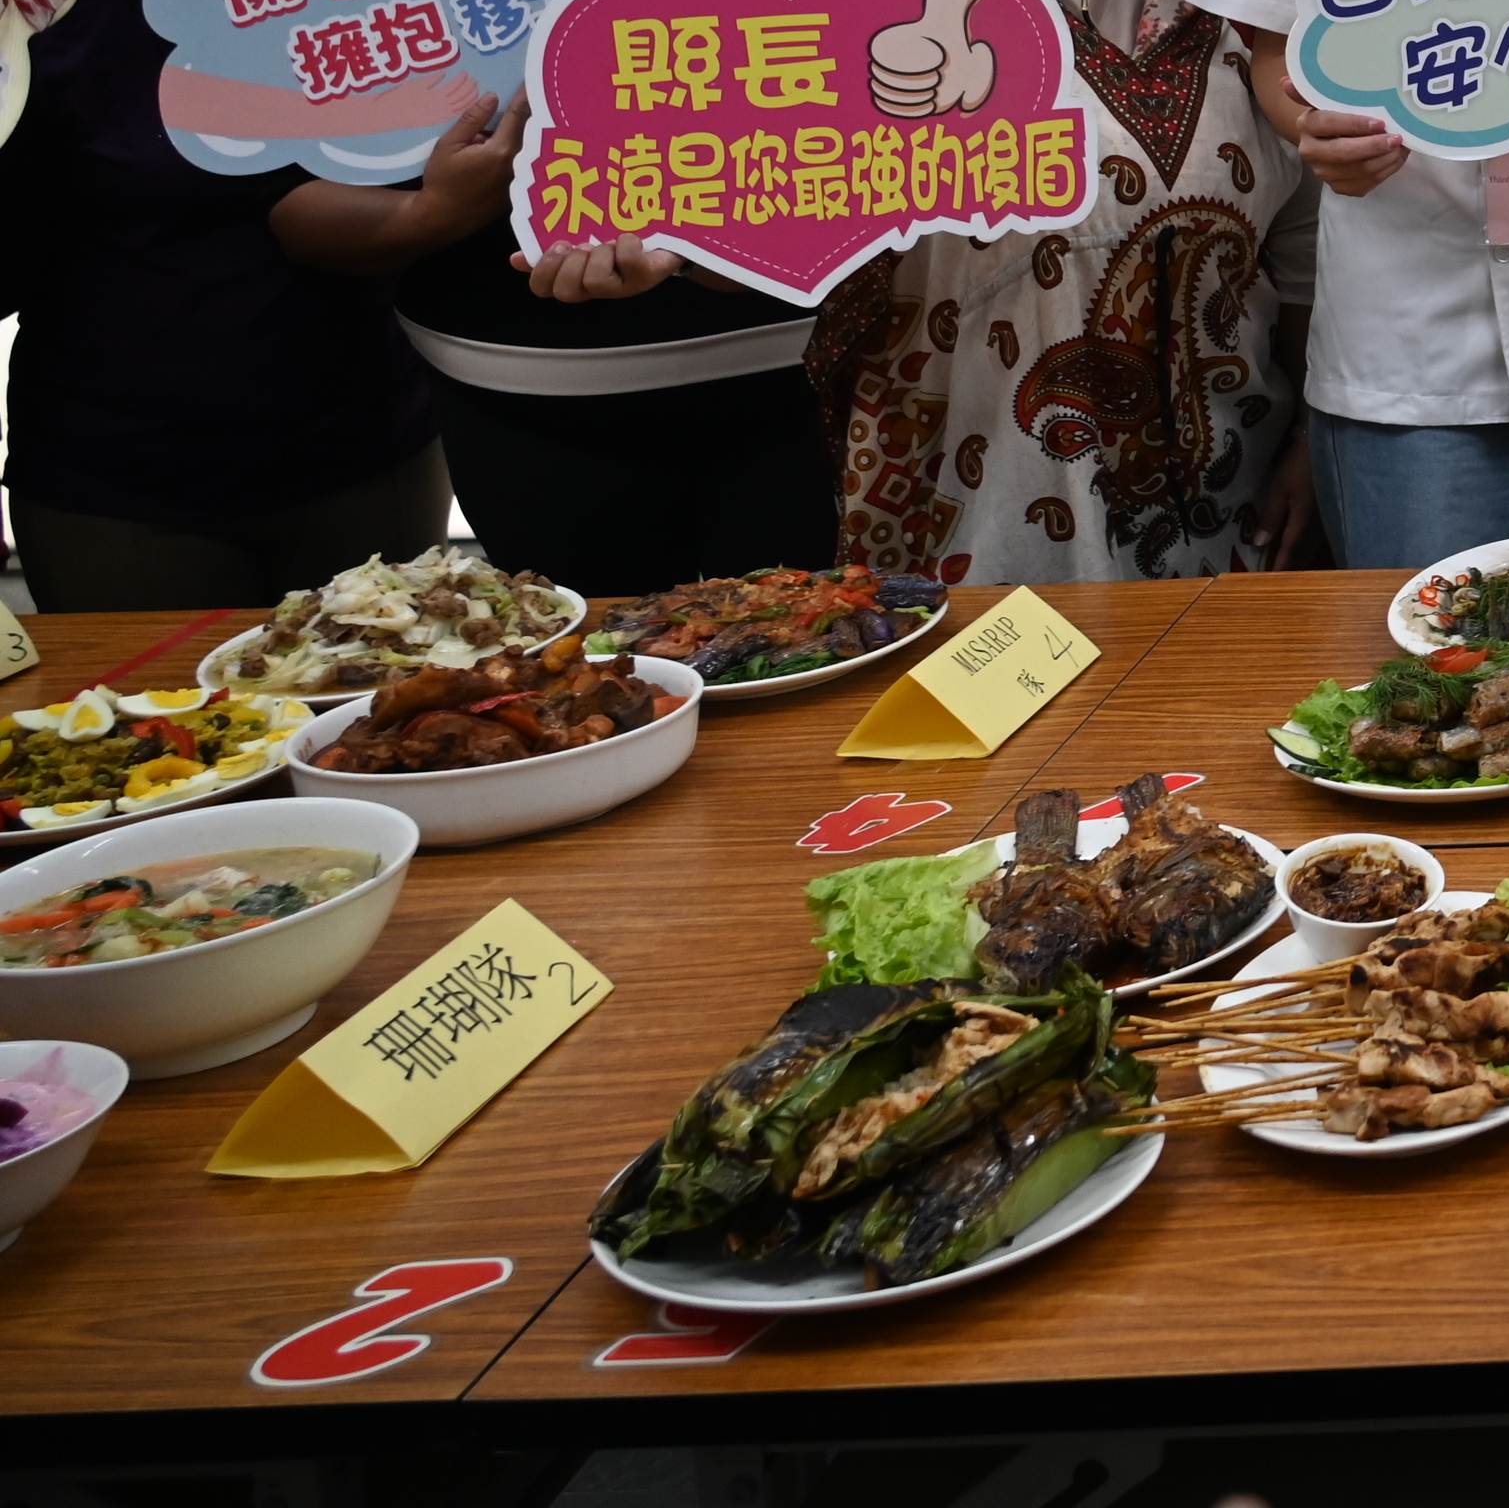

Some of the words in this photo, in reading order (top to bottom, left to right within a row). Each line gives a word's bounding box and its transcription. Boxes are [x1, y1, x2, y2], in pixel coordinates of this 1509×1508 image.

[292, 1, 459, 103] 擁抱
[611, 13, 838, 112] 縣長
[540, 119, 1075, 235] 永遠是您最強的後盾
[7, 633, 28, 662] 3
[951, 615, 1022, 677] MASARAP
[1016, 668, 1045, 697] 隊
[1044, 625, 1074, 668] 4
[362, 942, 537, 1081] 珊瑚隊
[548, 961, 599, 1006] 2
[250, 1256, 514, 1387] 2
